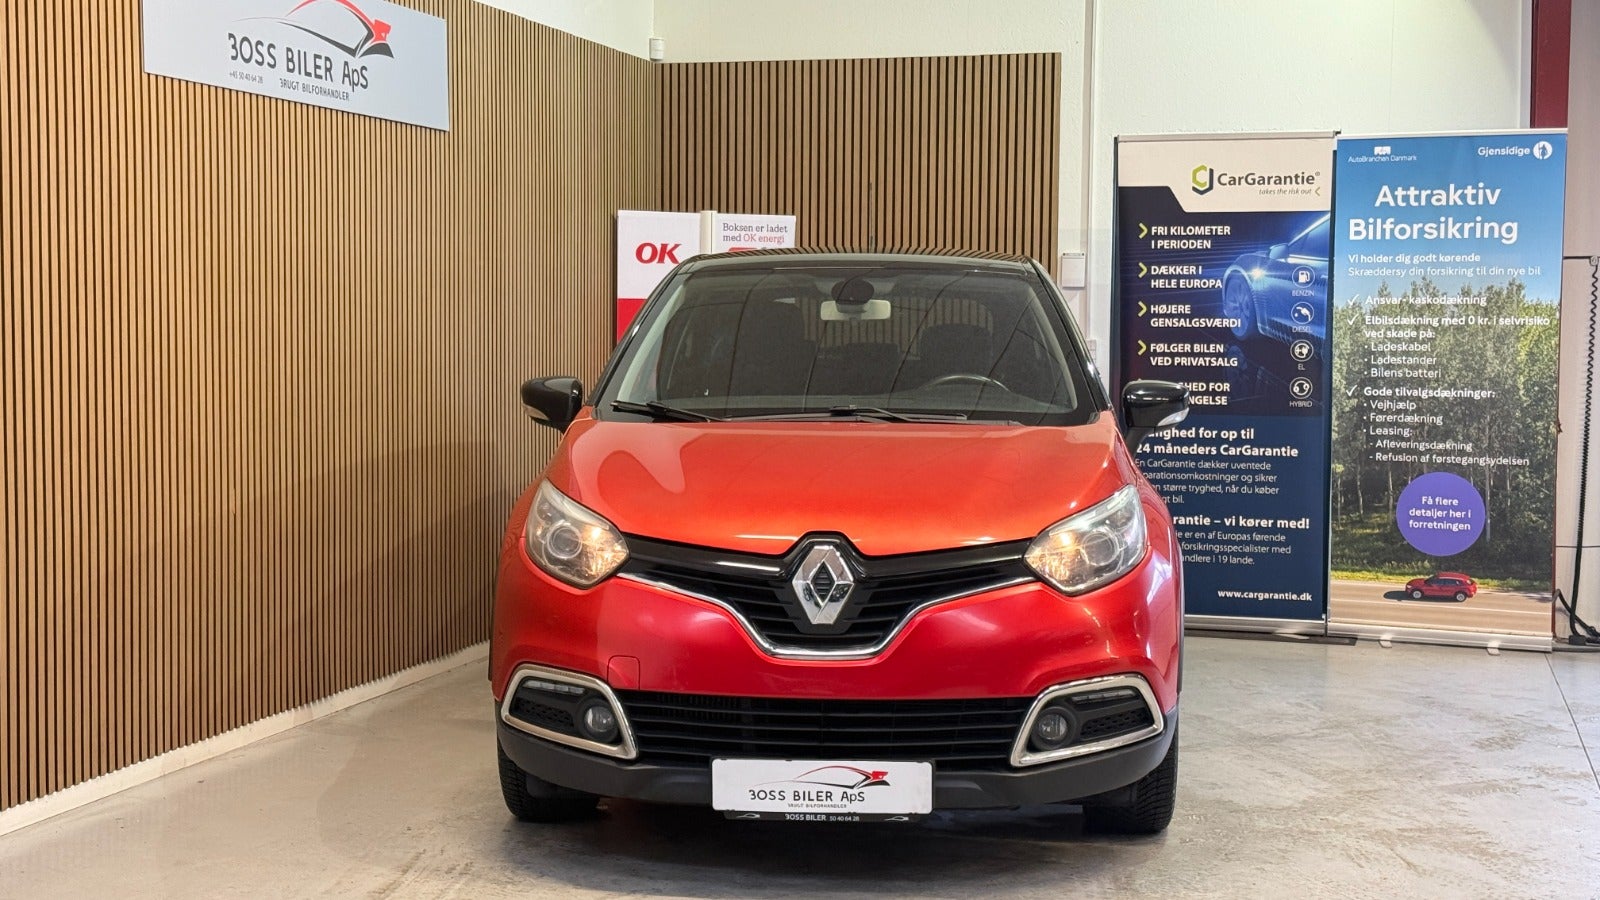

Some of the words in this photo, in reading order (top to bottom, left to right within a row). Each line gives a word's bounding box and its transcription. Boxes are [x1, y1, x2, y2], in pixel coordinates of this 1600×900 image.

[286, 47, 334, 82] BILER
[342, 60, 368, 92] ApS
[302, 82, 349, 101] BILFORHANDLER
[1478, 146, 1531, 156] Gjensidige
[1259, 187, 1275, 196] takes
[1277, 187, 1286, 195] the
[1288, 187, 1300, 195] risk
[1374, 182, 1502, 207] Attraktiv
[722, 223, 753, 232] Boksen
[766, 224, 788, 233] ladet
[1151, 226, 1168, 235] FRI
[1170, 226, 1231, 236] KILOMETER
[1349, 216, 1518, 244] Bilforsikring
[723, 234, 742, 242] med
[743, 234, 757, 242] OK
[758, 235, 785, 245] energi
[1151, 240, 1154, 249] I
[1157, 240, 1211, 249] PERIODEN
[635, 242, 682, 264] OK
[1348, 254, 1358, 263] Vi
[1361, 254, 1393, 263] holder
[1395, 254, 1411, 264] dig
[1413, 254, 1437, 264] godt
[1439, 254, 1480, 262] kørende
[1151, 266, 1196, 275] DÆKKER
[1199, 266, 1202, 274] I
[1348, 267, 1406, 277] Skræddersy
[1408, 267, 1424, 276] din
[1427, 266, 1473, 277] forsikring
[1476, 266, 1486, 275] til
[1489, 266, 1505, 275] din
[1507, 269, 1525, 277] nye
[1528, 266, 1540, 275] bil
[1151, 279, 1177, 288] HELE
[1180, 279, 1223, 289] EUROPA
[1365, 296, 1407, 304] Ansvar-
[1409, 296, 1487, 307] kaskodækning
[1151, 304, 1191, 314] HØJERE
[1151, 318, 1241, 328] GENSALGSVÆRDI
[1365, 315, 1439, 327] Elbilsdækning
[1441, 316, 1466, 325] med
[1468, 316, 1475, 325] 0
[1477, 316, 1490, 325] kr.
[1499, 316, 1550, 326] selvrisiko
[1365, 329, 1384, 338] ved
[1386, 329, 1416, 338] skade
[1419, 328, 1435, 340] på:
[1150, 343, 1191, 353] FØLGER
[1194, 343, 1224, 353] BILEN
[1371, 342, 1431, 352] Ladeskabel
[1150, 357, 1171, 366] VED
[1174, 357, 1238, 367] PRIVATSALG
[1371, 356, 1437, 365] Ladestander
[1371, 369, 1403, 377] Bilens
[1406, 369, 1441, 378] batteri
[1209, 383, 1230, 392] FOR
[1364, 388, 1392, 396] Gode
[1395, 387, 1496, 399] tilvalgsdækninger:
[1370, 400, 1416, 411] Vejhjælp
[1370, 414, 1443, 425] Førerdækning
[1199, 428, 1217, 438] for
[1220, 430, 1237, 441] op
[1241, 428, 1255, 439] til
[1370, 426, 1413, 436] Leasing:
[1154, 443, 1217, 455] måneders
[1220, 445, 1299, 457] CarGarantie
[1376, 440, 1472, 452] Afleveringsdækning
[1147, 459, 1196, 468] CarGarantie
[1198, 460, 1229, 469] dækker
[1231, 462, 1271, 470] uventede
[1376, 453, 1418, 463] Refusion
[1420, 453, 1430, 463] af
[1432, 454, 1530, 467] førstegangsydelsen
[1143, 472, 1239, 483] parationsomkostninger
[1241, 474, 1252, 484] og
[1254, 474, 1277, 482] sikrer
[1189, 484, 1224, 494] tryghed,
[1225, 485, 1239, 493] når
[1241, 486, 1253, 494] du
[1255, 486, 1279, 495] køber
[1173, 495, 1185, 503] bil.
[1422, 496, 1433, 505] Få
[1435, 496, 1458, 505] flere
[1409, 509, 1447, 519] detaljer
[1450, 509, 1466, 518] her
[1224, 516, 1236, 526] vi
[1239, 516, 1274, 528] kører
[1277, 518, 1310, 529] med!
[1409, 520, 1471, 532] forretningen
[1208, 531, 1216, 540] af
[1218, 532, 1251, 542] Europas
[1253, 532, 1286, 542] førende
[1181, 542, 1269, 553] forsikringsspecialister
[1272, 546, 1291, 554] med
[1218, 555, 1228, 563] 19
[1230, 555, 1255, 564] lande.
[1218, 590, 1312, 601] www.cargarantie.dk
[793, 790, 833, 802] BILER
[841, 792, 865, 804] ApS
